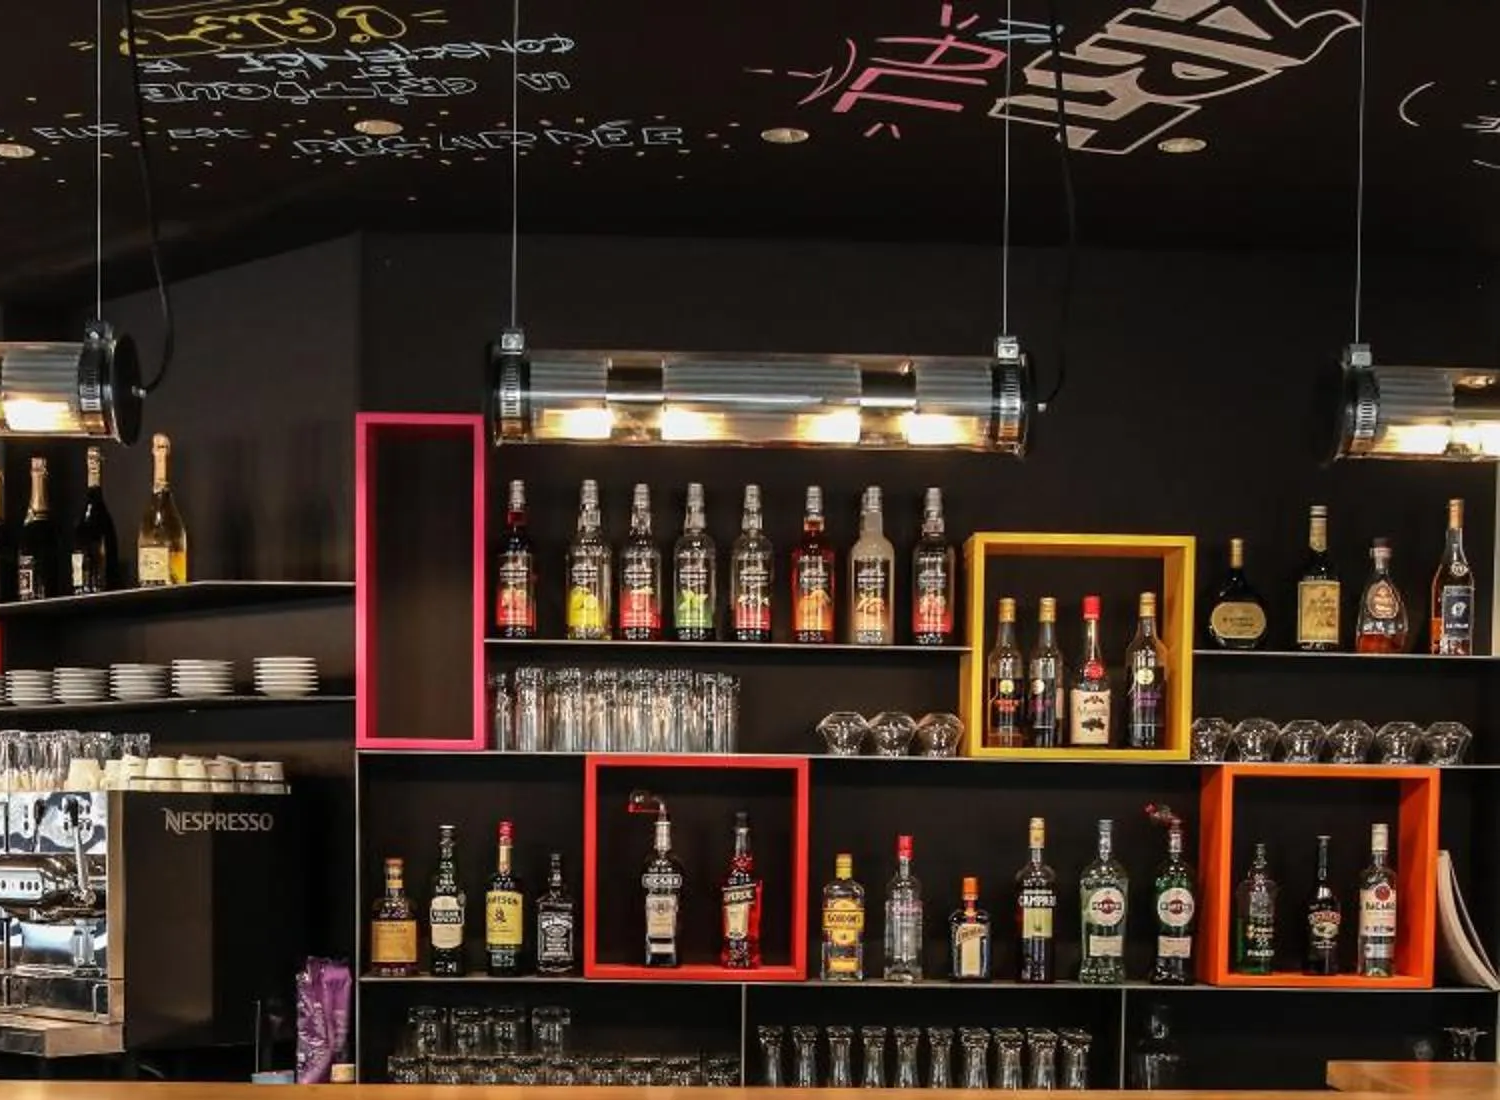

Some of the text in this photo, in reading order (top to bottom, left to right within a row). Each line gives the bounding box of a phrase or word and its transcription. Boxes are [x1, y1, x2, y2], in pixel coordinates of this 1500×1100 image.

[832, 34, 1008, 113] ALL
[136, 75, 478, 105] CRITIQUE
[161, 806, 275, 836] NESPRESSO
